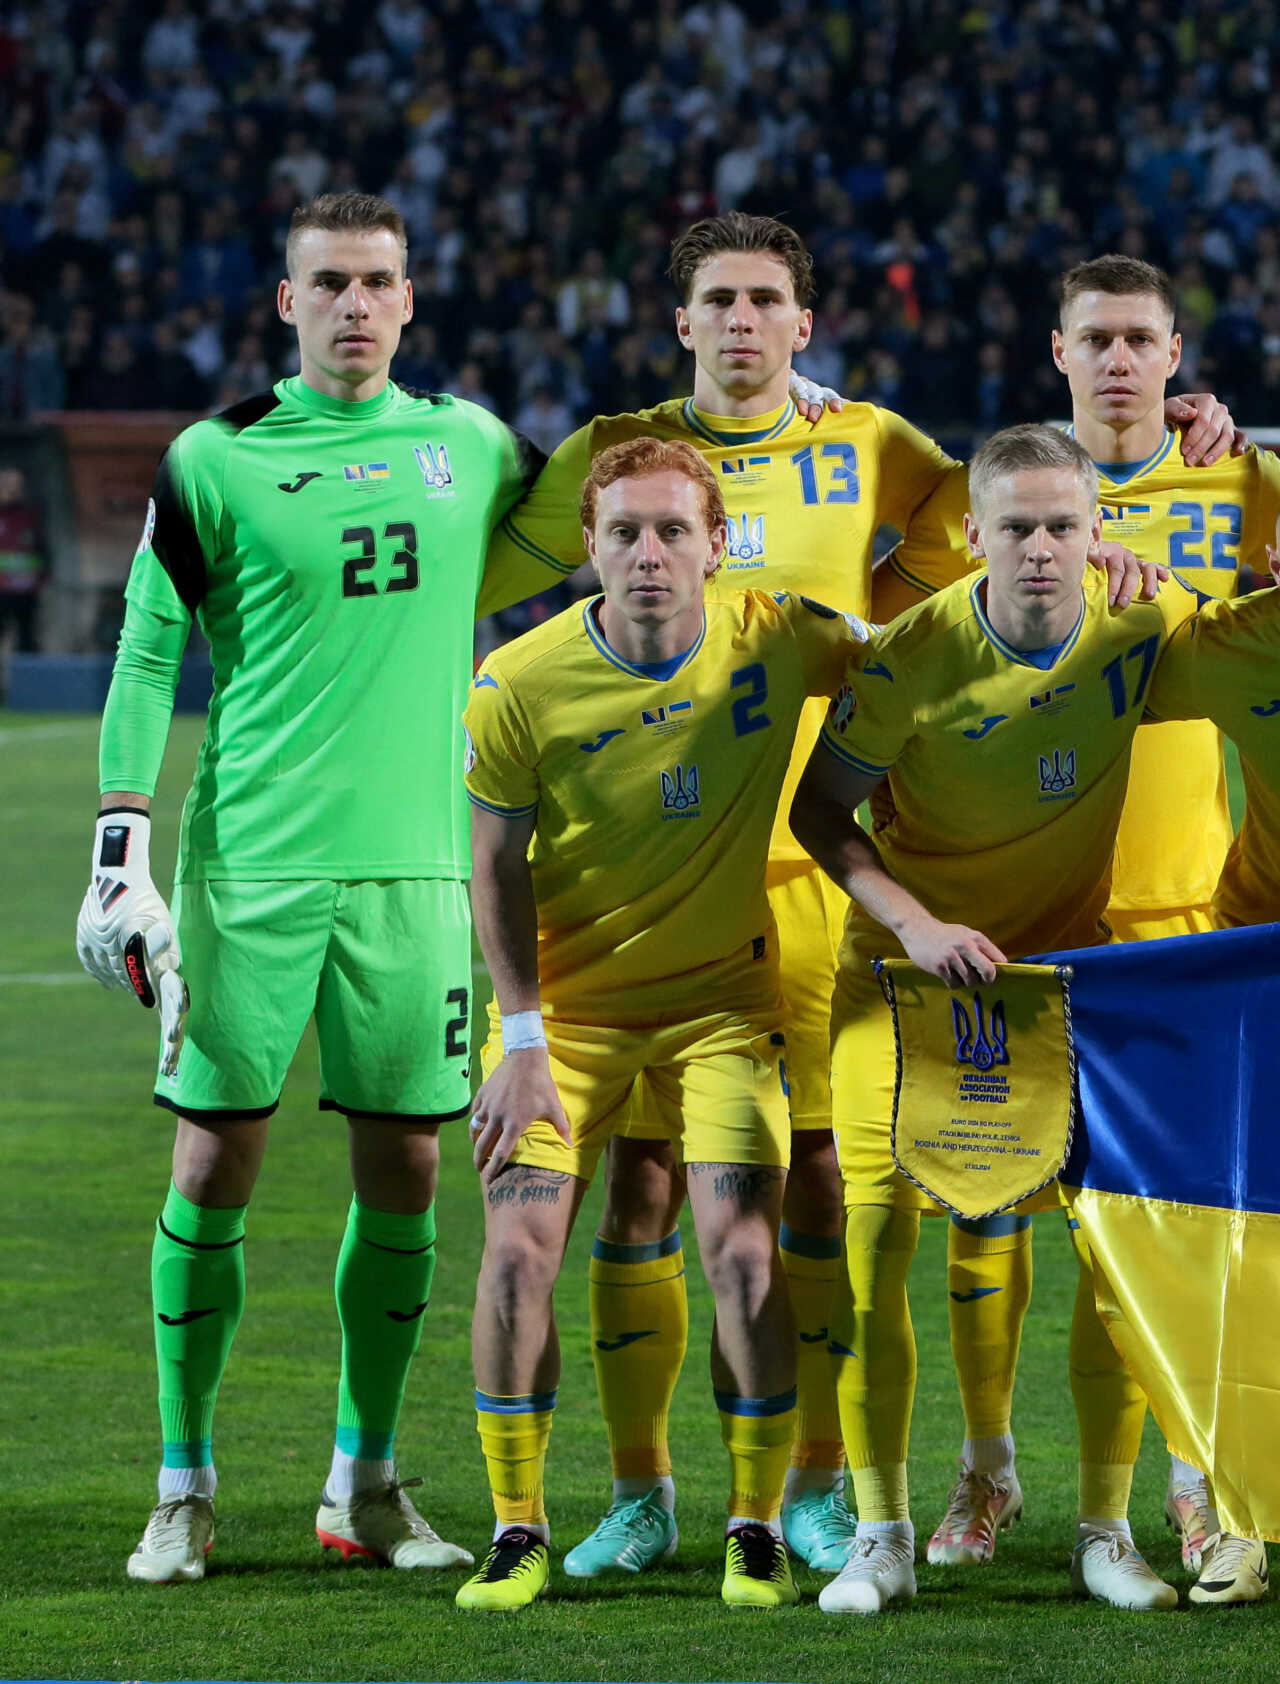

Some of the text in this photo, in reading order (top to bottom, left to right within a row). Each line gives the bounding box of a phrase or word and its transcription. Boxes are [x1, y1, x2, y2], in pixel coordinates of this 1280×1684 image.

[789, 442, 860, 506] 13
[340, 521, 420, 598] 23
[1168, 502, 1243, 571] 22
[727, 560, 766, 570] UKRAINE
[730, 662, 772, 737] 2
[1101, 632, 1160, 719] 17
[127, 955, 145, 995] adidas
[959, 1083, 1011, 1095] ASSOCIATION
[968, 1094, 1009, 1105] FOOTBALL
[914, 1139, 940, 1149] BOSNIA
[942, 1141, 958, 1150] AND
[959, 1143, 1007, 1154] HERZEGOVINA
[1013, 1147, 1041, 1156] UKRAINE
